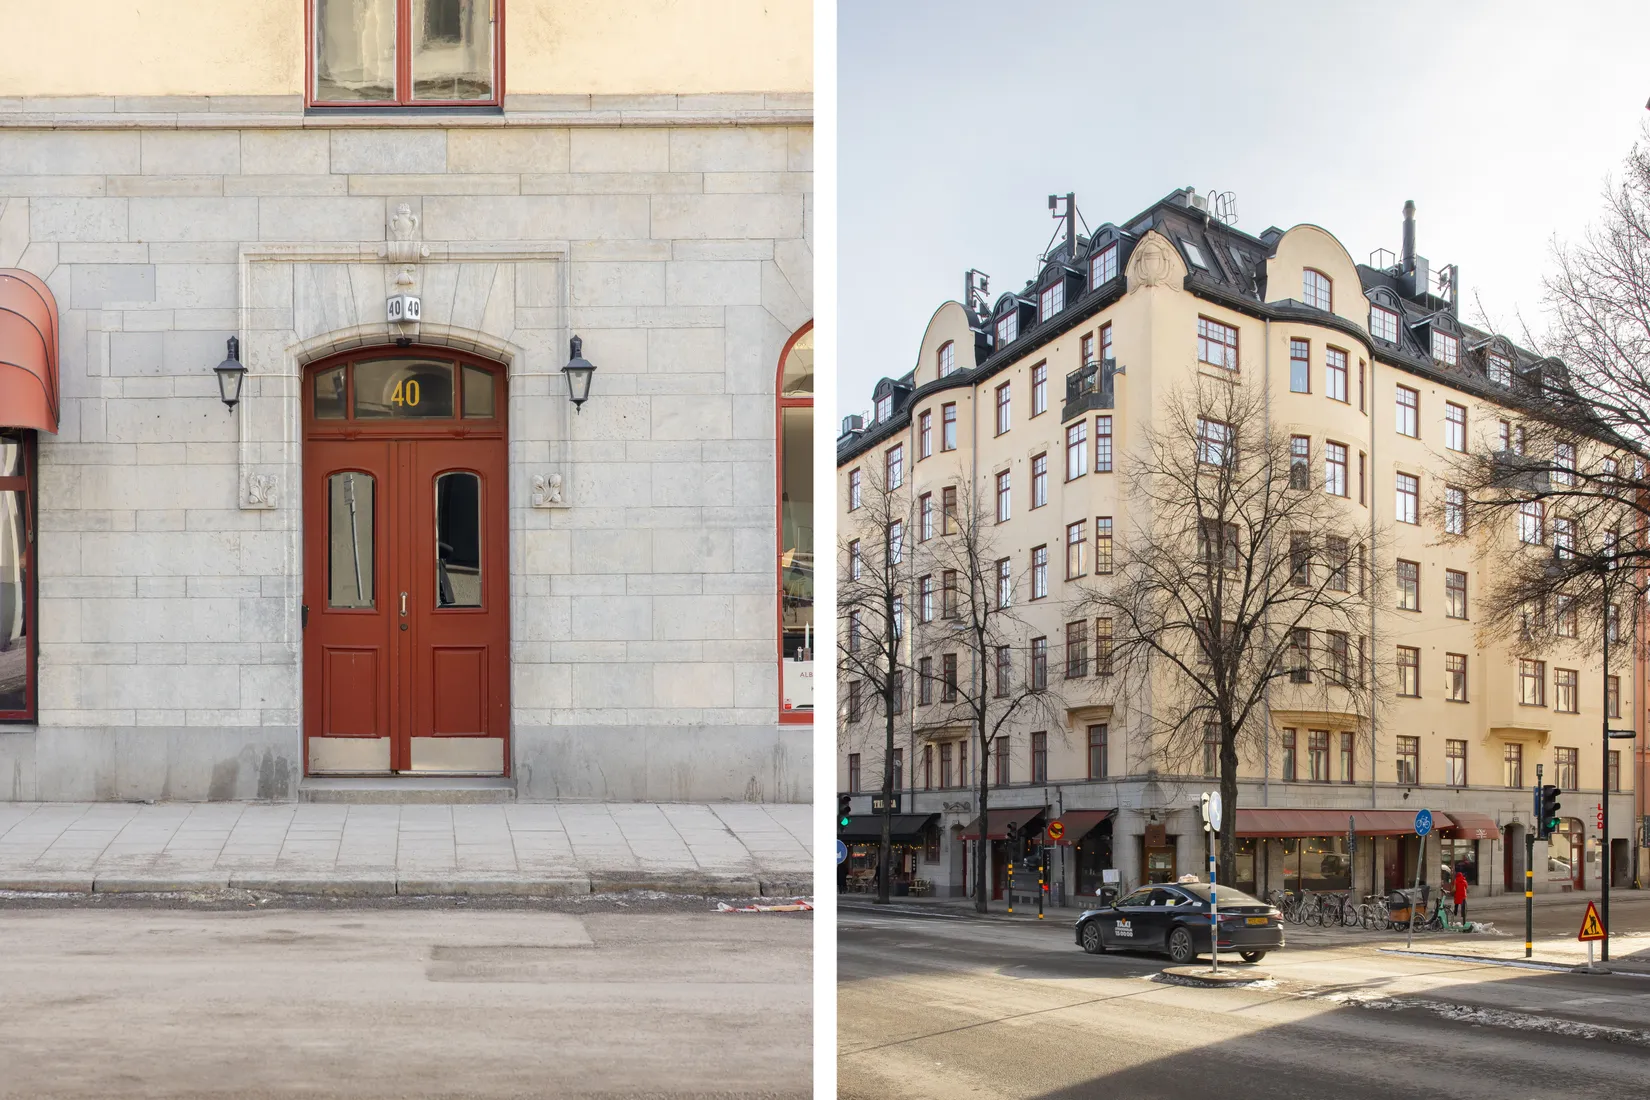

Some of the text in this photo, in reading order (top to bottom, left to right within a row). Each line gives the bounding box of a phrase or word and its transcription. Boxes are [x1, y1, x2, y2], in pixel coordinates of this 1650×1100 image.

[389, 300, 401, 317] 40
[408, 300, 419, 317] 40
[391, 379, 420, 407] 40
